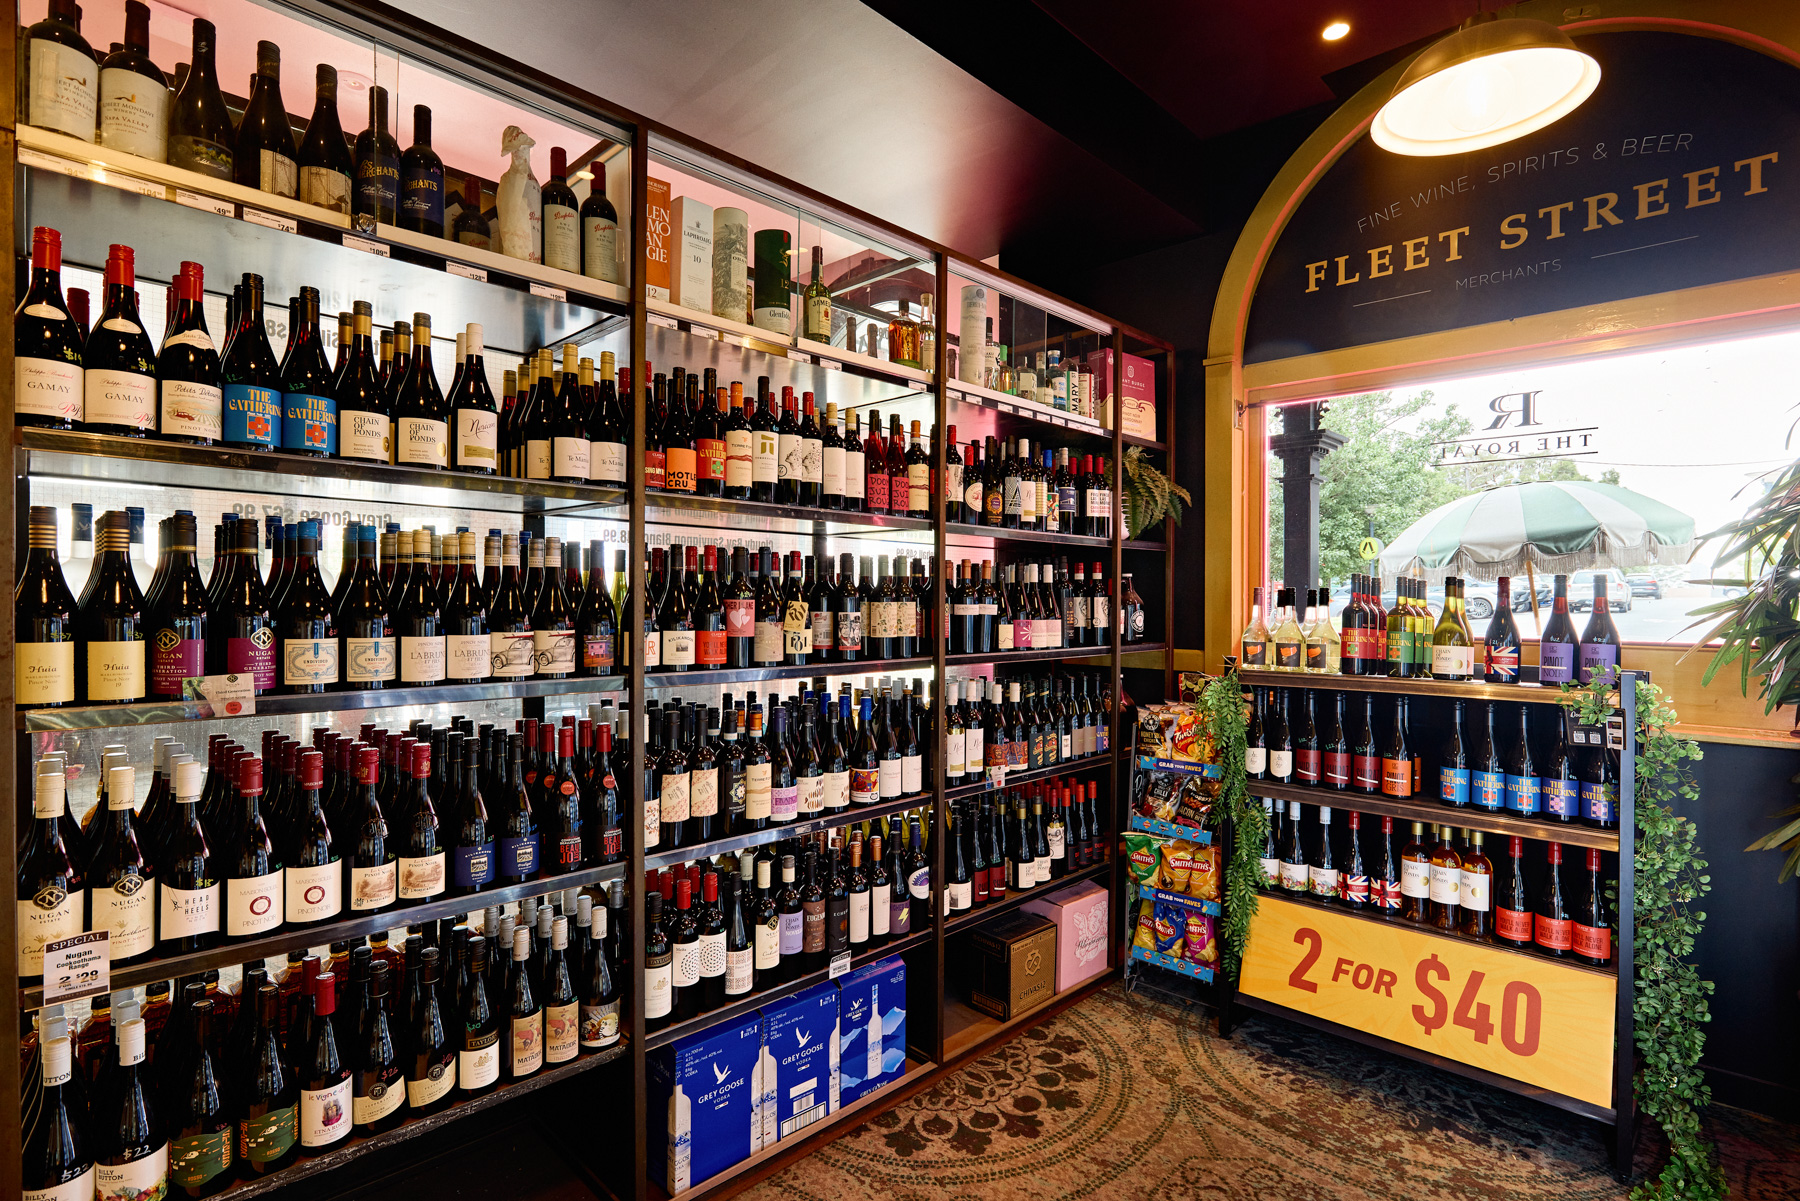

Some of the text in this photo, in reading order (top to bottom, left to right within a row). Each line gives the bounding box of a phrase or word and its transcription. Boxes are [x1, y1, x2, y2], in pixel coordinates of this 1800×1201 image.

[1356, 202, 1403, 234] FINE
[1487, 146, 1580, 183] SPIRITS
[1592, 142, 1608, 160] &
[1620, 133, 1694, 157] BEER
[646, 204, 670, 222] LEN
[1305, 151, 1779, 293] FLEET STREET
[646, 246, 668, 263] GIE
[693, 254, 702, 264] 10
[1455, 258, 1562, 291] MERCHANTS
[780, 278, 790, 290] 12
[647, 287, 657, 298] 12
[27, 381, 71, 394] GAMAY
[105, 392, 145, 404] GAMAY
[247, 389, 271, 404] THE
[305, 398, 327, 412] THE
[353, 416, 380, 426] CHAIN
[354, 429, 382, 438] PONDS
[409, 423, 434, 432] CHAIN
[409, 434, 436, 443] PONDS
[668, 480, 688, 488] CRU
[1544, 669, 1564, 678] NOIR
[1443, 768, 1455, 777] THE
[1483, 774, 1497, 782] THE
[1386, 784, 1405, 792] GRIS
[1518, 778, 1532, 786] THE
[1550, 780, 1564, 789] THE
[1131, 851, 1154, 863] SMITH'S
[111, 896, 147, 908] NUGAN
[1158, 892, 1174, 901] GRAB
[1184, 899, 1201, 908] FAVES
[184, 902, 210, 915] HEELS
[298, 904, 331, 915] PINOT NOIR
[29, 909, 70, 921] NUGAN
[242, 914, 278, 927] PINOT NOIR
[52, 933, 103, 951] SPECIAL
[65, 950, 92, 960] Nugan
[56, 955, 102, 969] Cookoothama
[68, 962, 90, 970] Range
[1288, 928, 1542, 1057] 2 FOR $40
[782, 1042, 824, 1066] GREY GOOSE
[796, 1056, 812, 1066] VODKA
[44, 1071, 70, 1084] UTTON
[698, 1078, 744, 1104] GREY GOOSE
[713, 1094, 730, 1104] VODKA
[314, 1127, 331, 1135] ETNA
